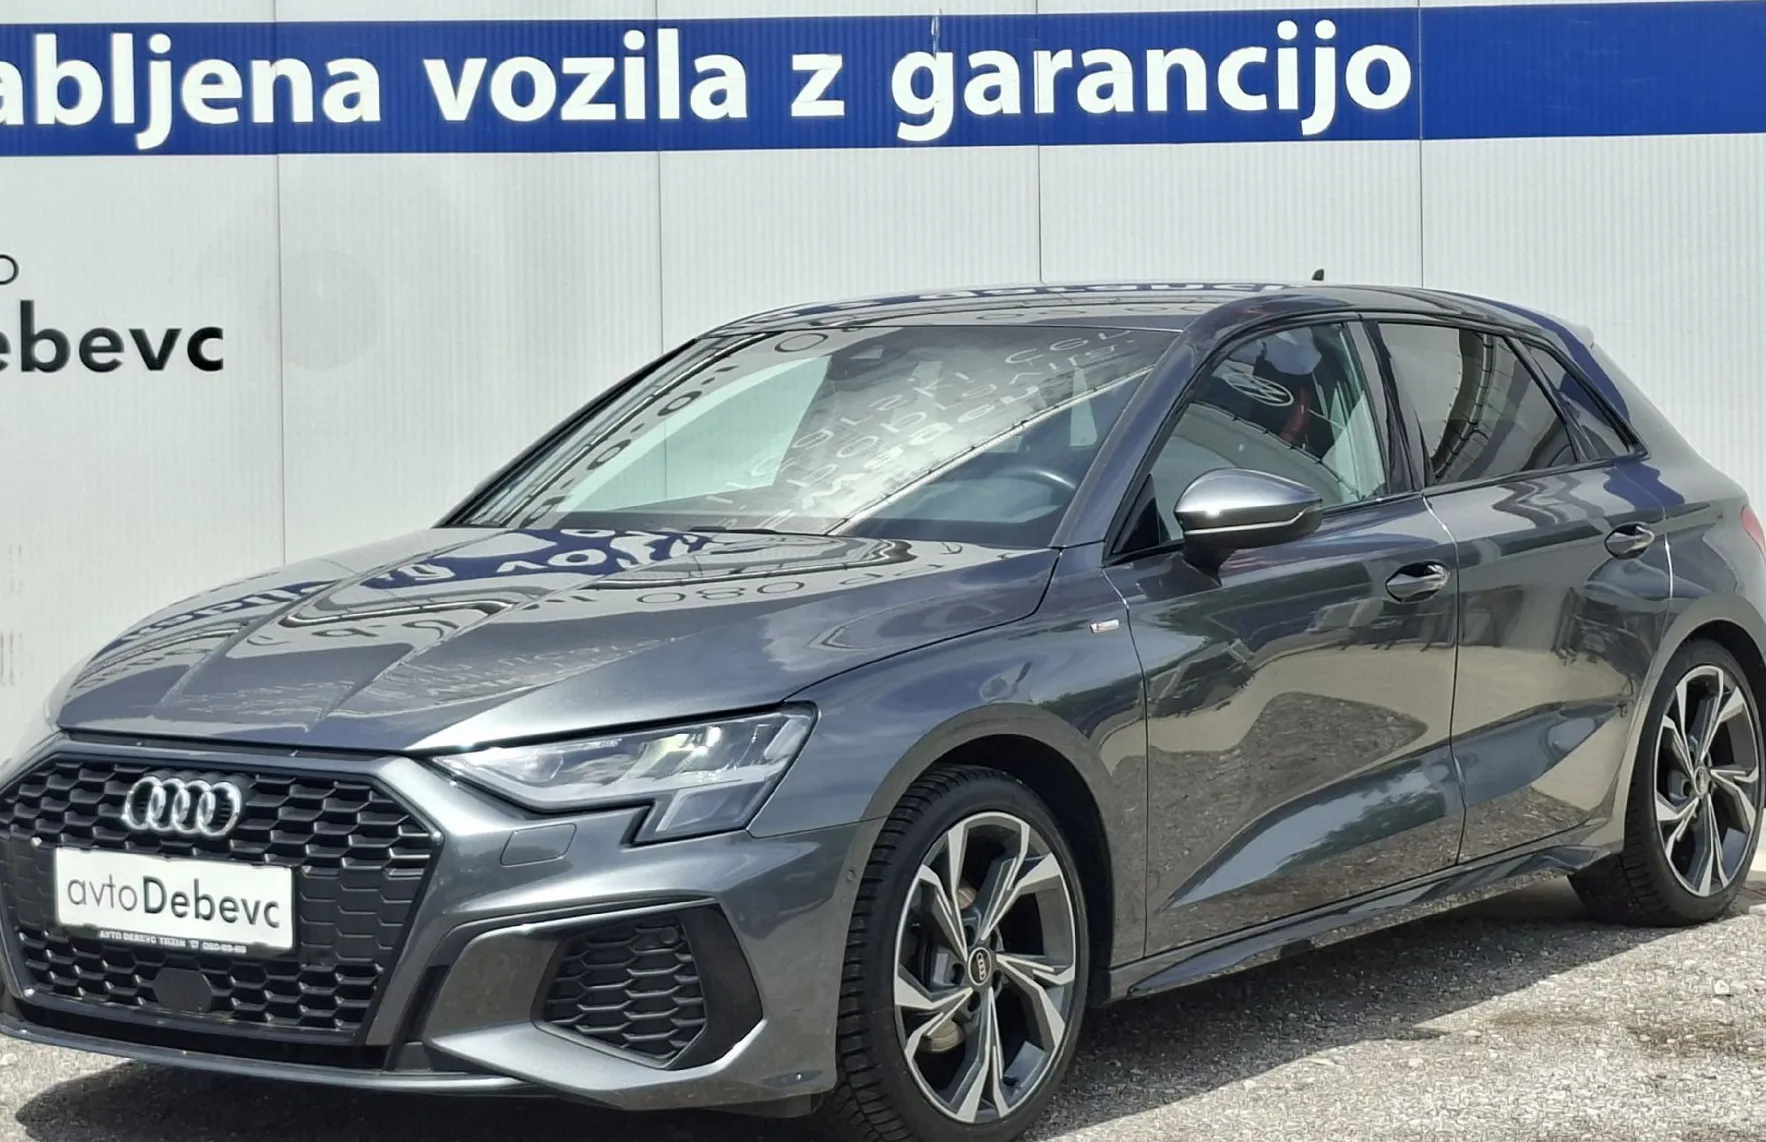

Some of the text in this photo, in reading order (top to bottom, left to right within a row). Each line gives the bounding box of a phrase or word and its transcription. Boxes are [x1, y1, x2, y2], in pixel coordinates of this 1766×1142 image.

[423, 28, 748, 122] vozila
[790, 53, 845, 117] z
[891, 20, 1412, 142] garancijo
[0, 299, 224, 373] bevc
